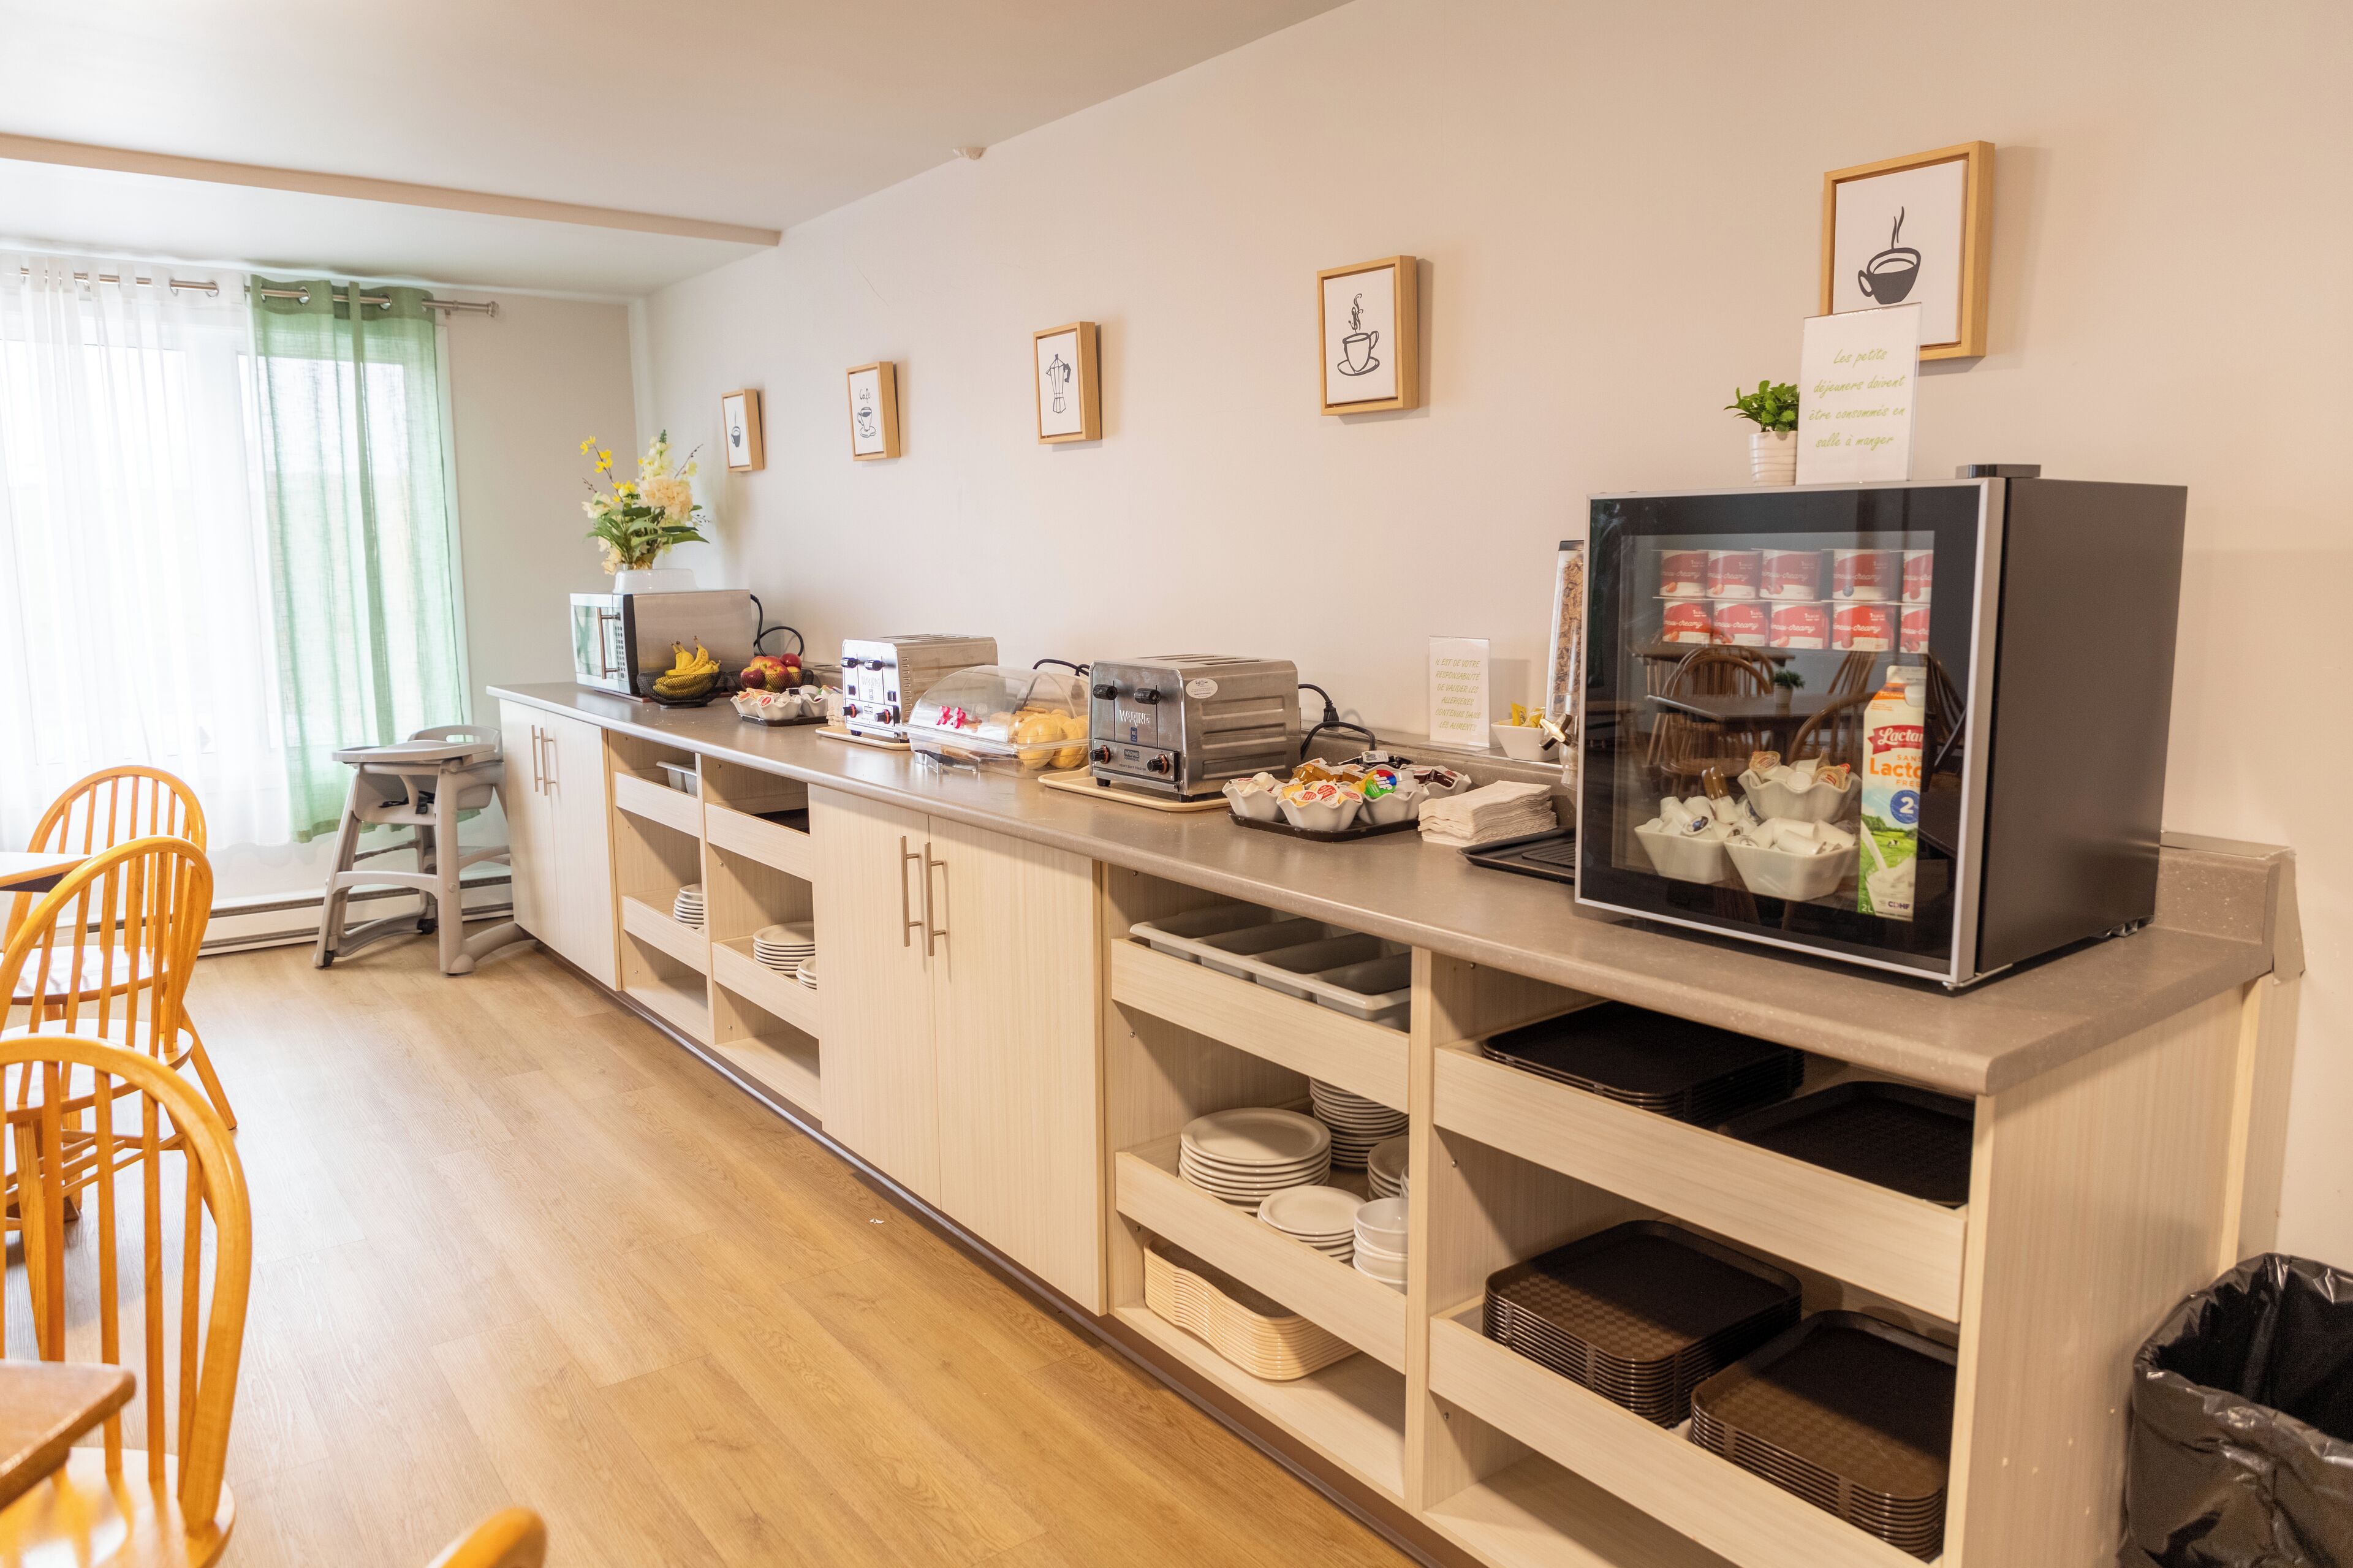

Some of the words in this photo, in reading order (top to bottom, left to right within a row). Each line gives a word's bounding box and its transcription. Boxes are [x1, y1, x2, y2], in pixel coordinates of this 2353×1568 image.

[1833, 349, 1852, 365] Les
[1852, 347, 1888, 368] petits
[1813, 379, 1863, 398] déjeuners
[1867, 374, 1906, 389] doivent
[1808, 409, 1832, 421] être
[1835, 404, 1889, 419] consommés
[1892, 406, 1906, 417] en
[1815, 432, 1841, 448] salle
[1845, 434, 1854, 446] à
[1855, 436, 1893, 451] manger
[1461, 659, 1481, 668] VOTRE
[1446, 684, 1468, 692] VALIDER
[1118, 709, 1151, 727] WARING
[1435, 708, 1465, 718] CONTENUS
[1465, 711, 1482, 719] DANS
[1450, 722, 1477, 732] ALIMENTS
[1895, 779, 1922, 787] FREE
[1900, 796, 1914, 814] 2
